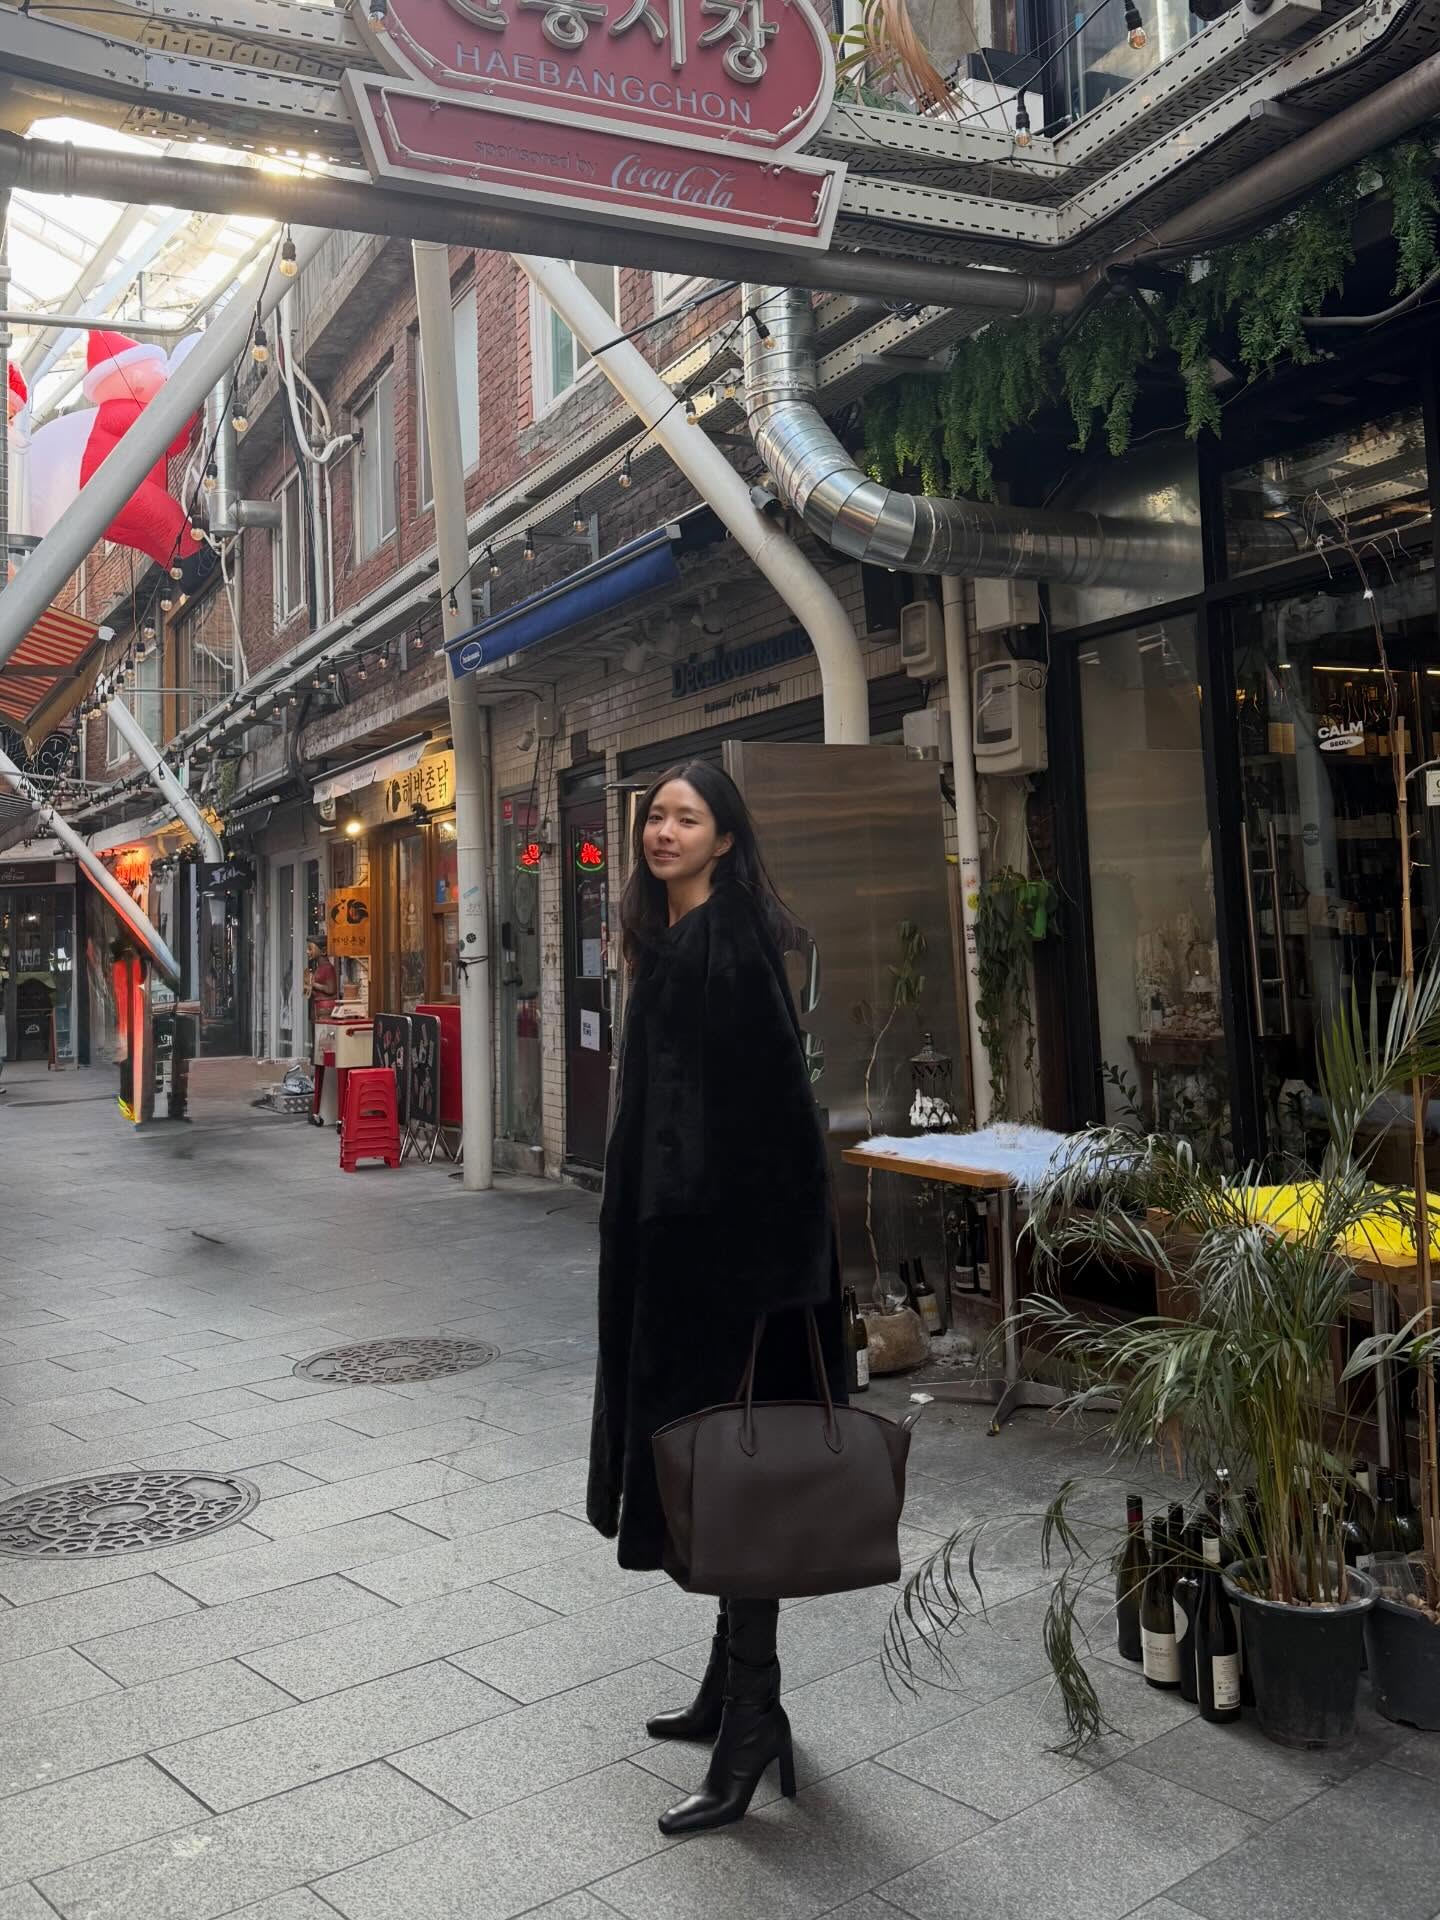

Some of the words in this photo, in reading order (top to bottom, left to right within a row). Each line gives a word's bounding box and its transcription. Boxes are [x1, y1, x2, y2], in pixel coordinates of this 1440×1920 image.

[446, 0, 780, 84] 시장
[455, 43, 752, 124] HAEBANGCHON
[472, 140, 572, 170] sponsored
[575, 151, 597, 177] by
[610, 152, 737, 209] Coca-Cola
[1317, 720, 1364, 739] CALM
[1329, 739, 1353, 748] SEOUL
[401, 759, 449, 806] 해방촌닭
